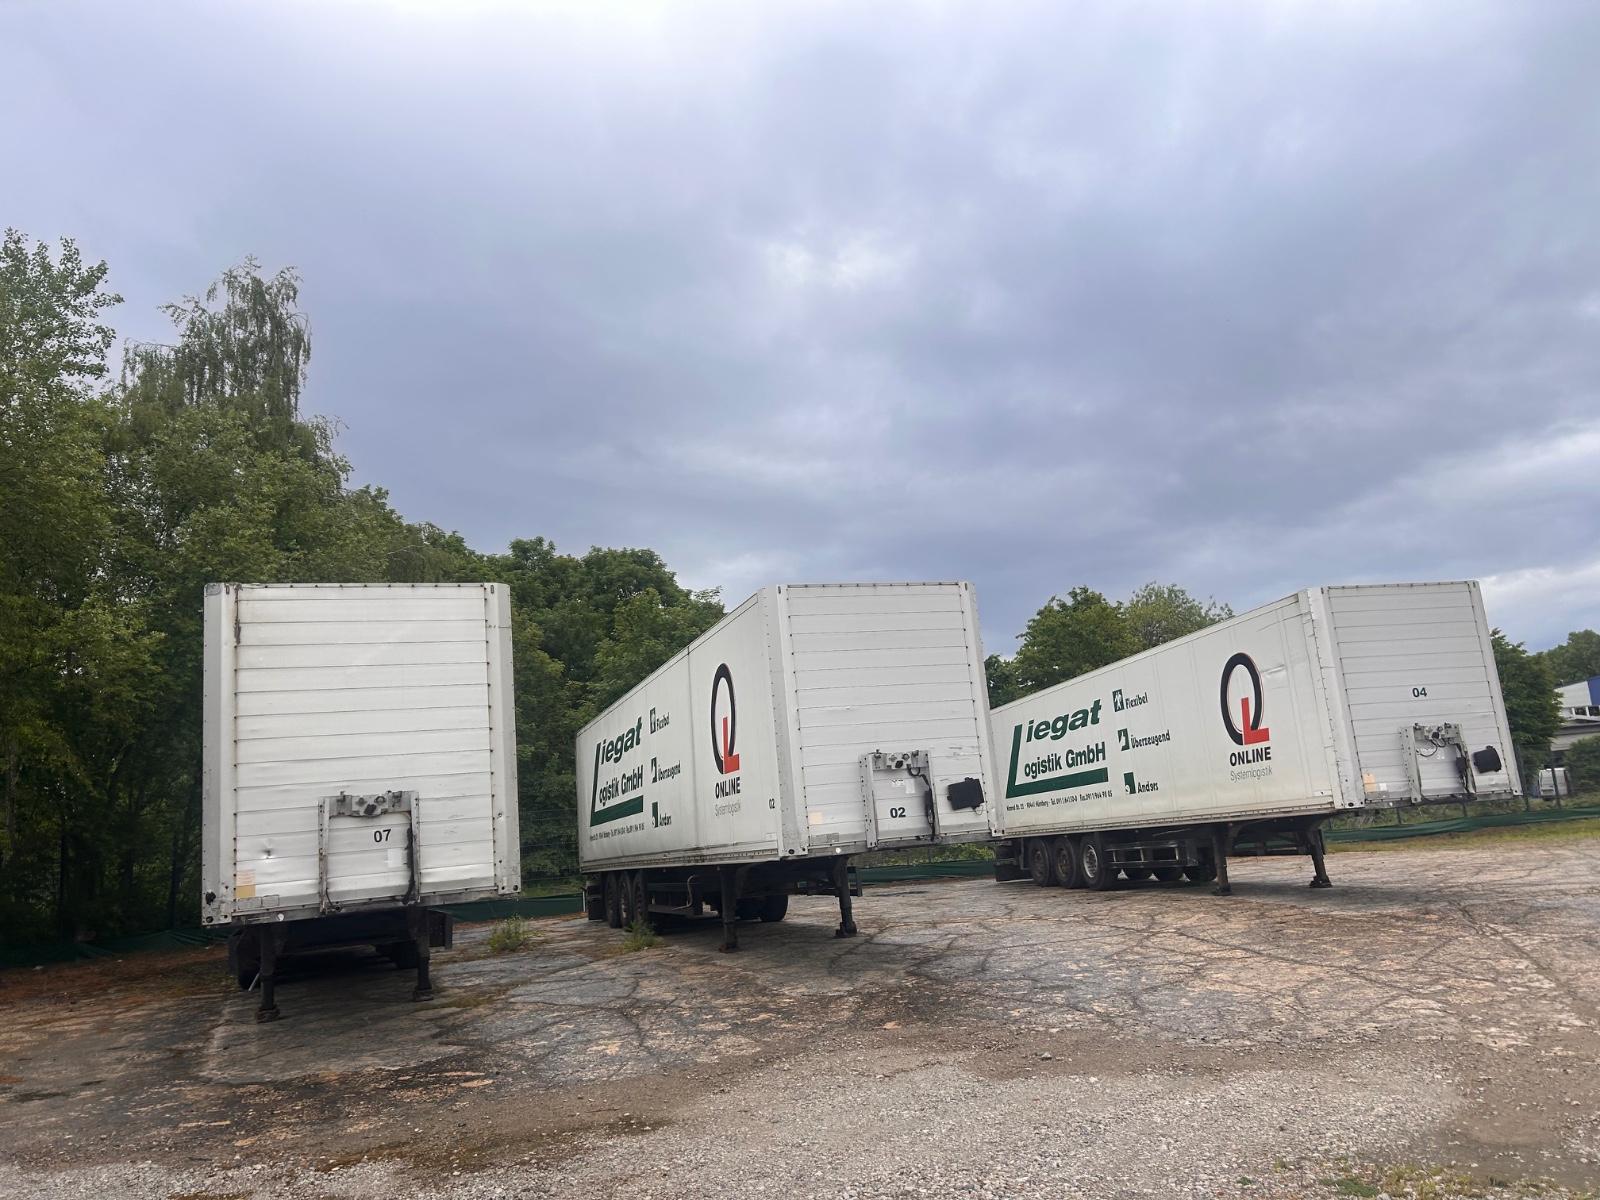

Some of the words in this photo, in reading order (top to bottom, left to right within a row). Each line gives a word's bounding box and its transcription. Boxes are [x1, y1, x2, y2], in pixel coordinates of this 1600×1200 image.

[1412, 687, 1428, 699] 04
[1065, 741, 1107, 769] GmbH
[1229, 746, 1272, 767] ONLINE
[621, 764, 644, 795] GmbH
[715, 777, 741, 799] ONLINE
[890, 807, 906, 819] 02
[374, 829, 391, 843] 07
